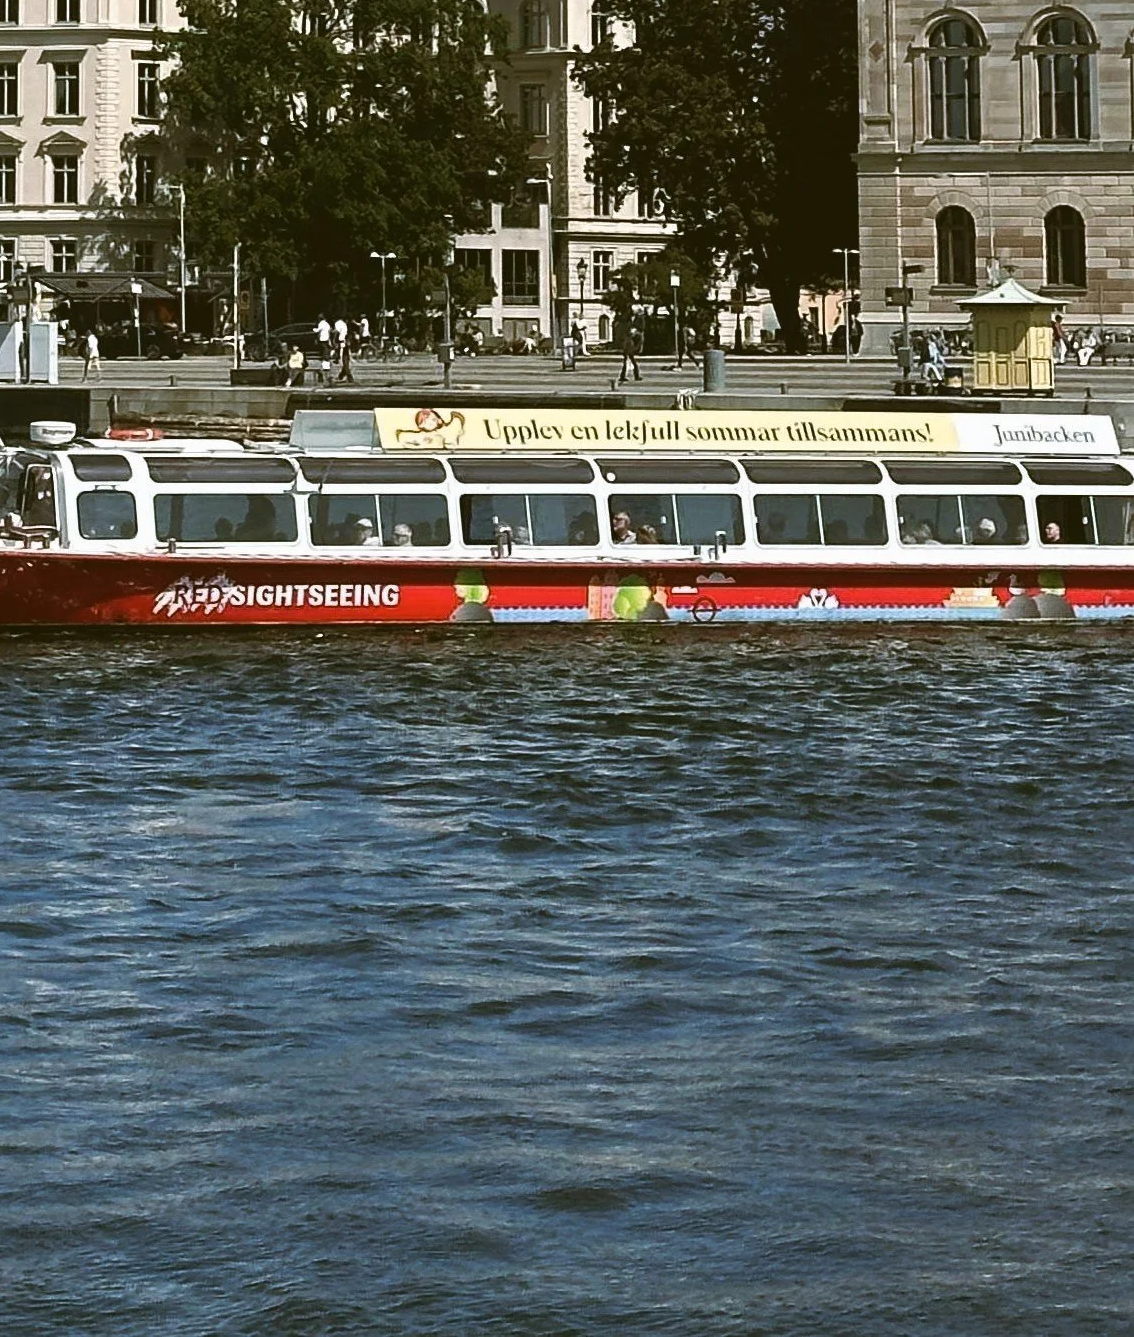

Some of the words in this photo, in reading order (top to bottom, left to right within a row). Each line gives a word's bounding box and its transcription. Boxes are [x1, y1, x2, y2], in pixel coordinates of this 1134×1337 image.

[483, 418, 563, 445] Upplev
[570, 425, 600, 441] en
[606, 419, 680, 446] lekfull
[686, 425, 780, 442] sommar
[786, 421, 935, 443] tillsammans!
[992, 424, 1096, 447] Junibacken
[228, 584, 400, 607] SIGHTSEEING
